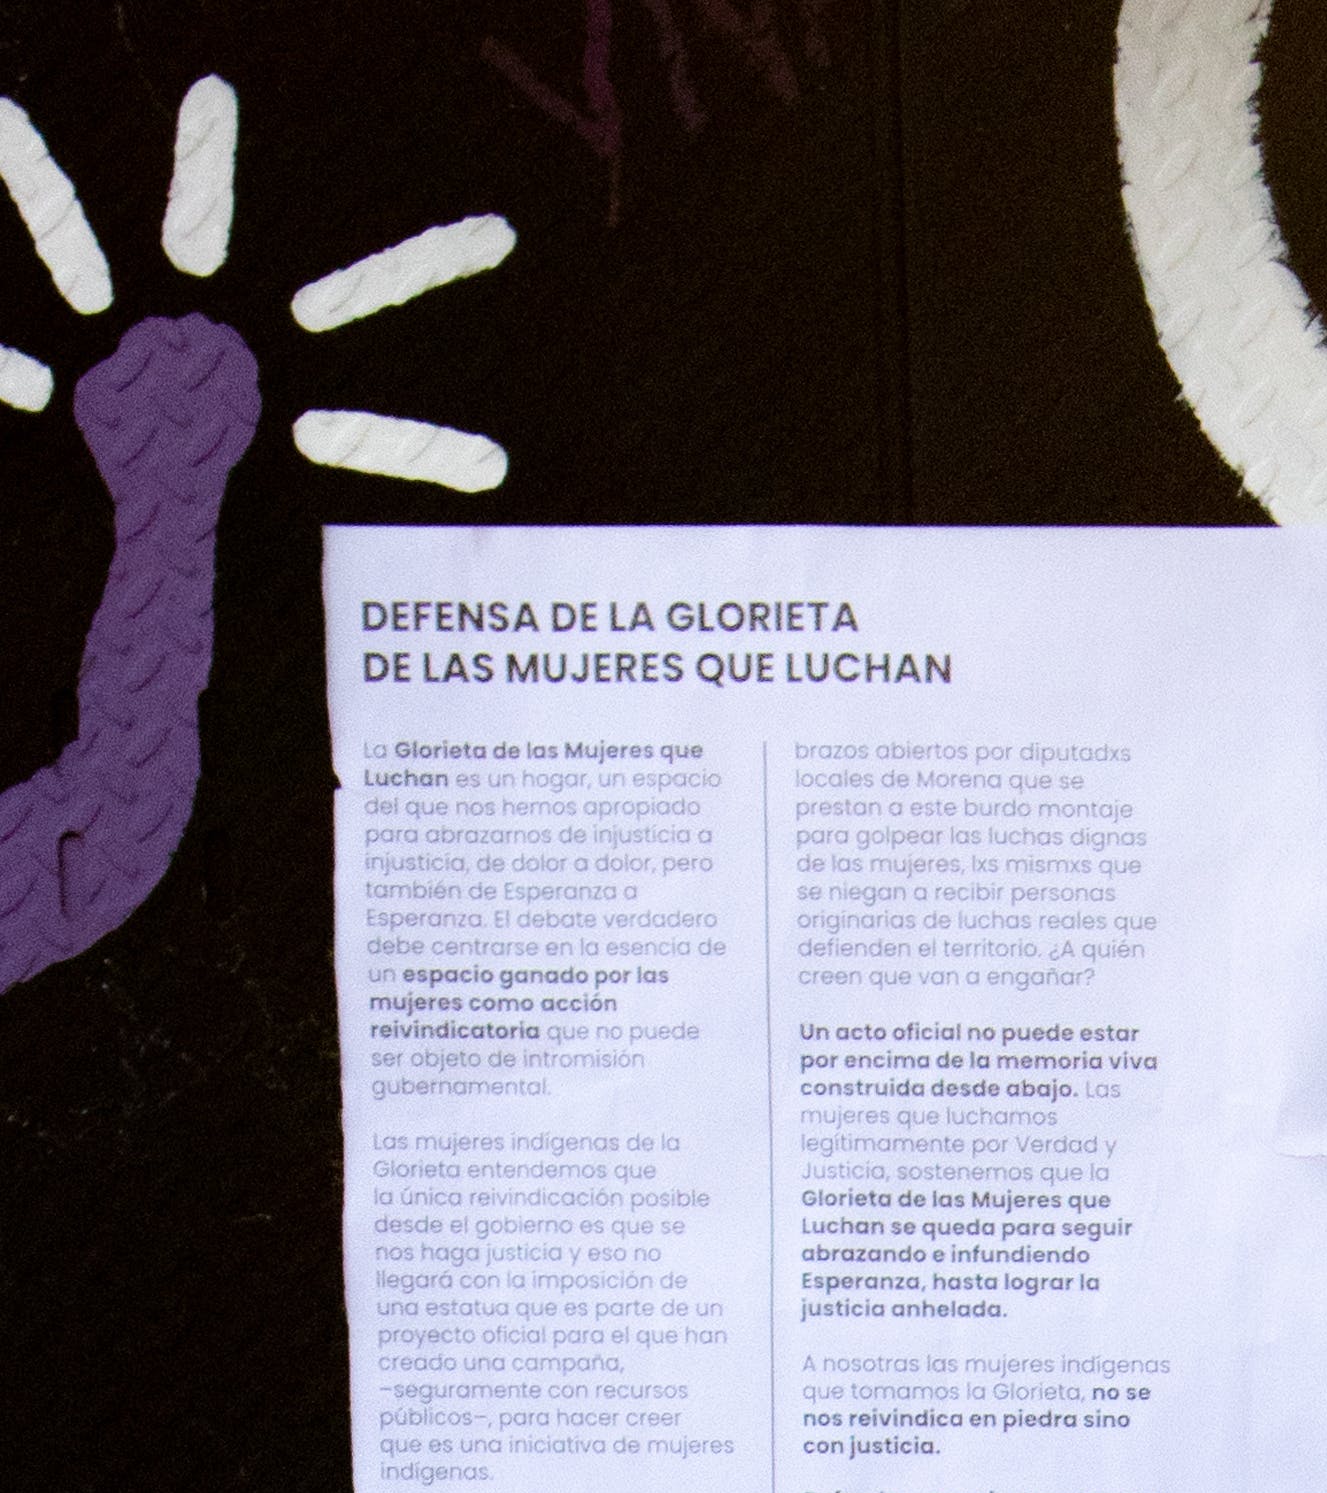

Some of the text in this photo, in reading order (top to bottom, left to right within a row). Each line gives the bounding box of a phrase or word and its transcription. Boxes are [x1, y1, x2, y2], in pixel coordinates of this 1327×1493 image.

[361, 601, 859, 633] DEFENSA DE LA GLORIETA
[363, 651, 952, 688] DE LAS MUJERES QUE LUCHAN
[799, 1021, 1140, 1047] Un acto oficial no puede estar
[800, 1049, 1158, 1075] por encima de la memoria viva
[800, 1077, 1122, 1104] construida desde abajo. Las
